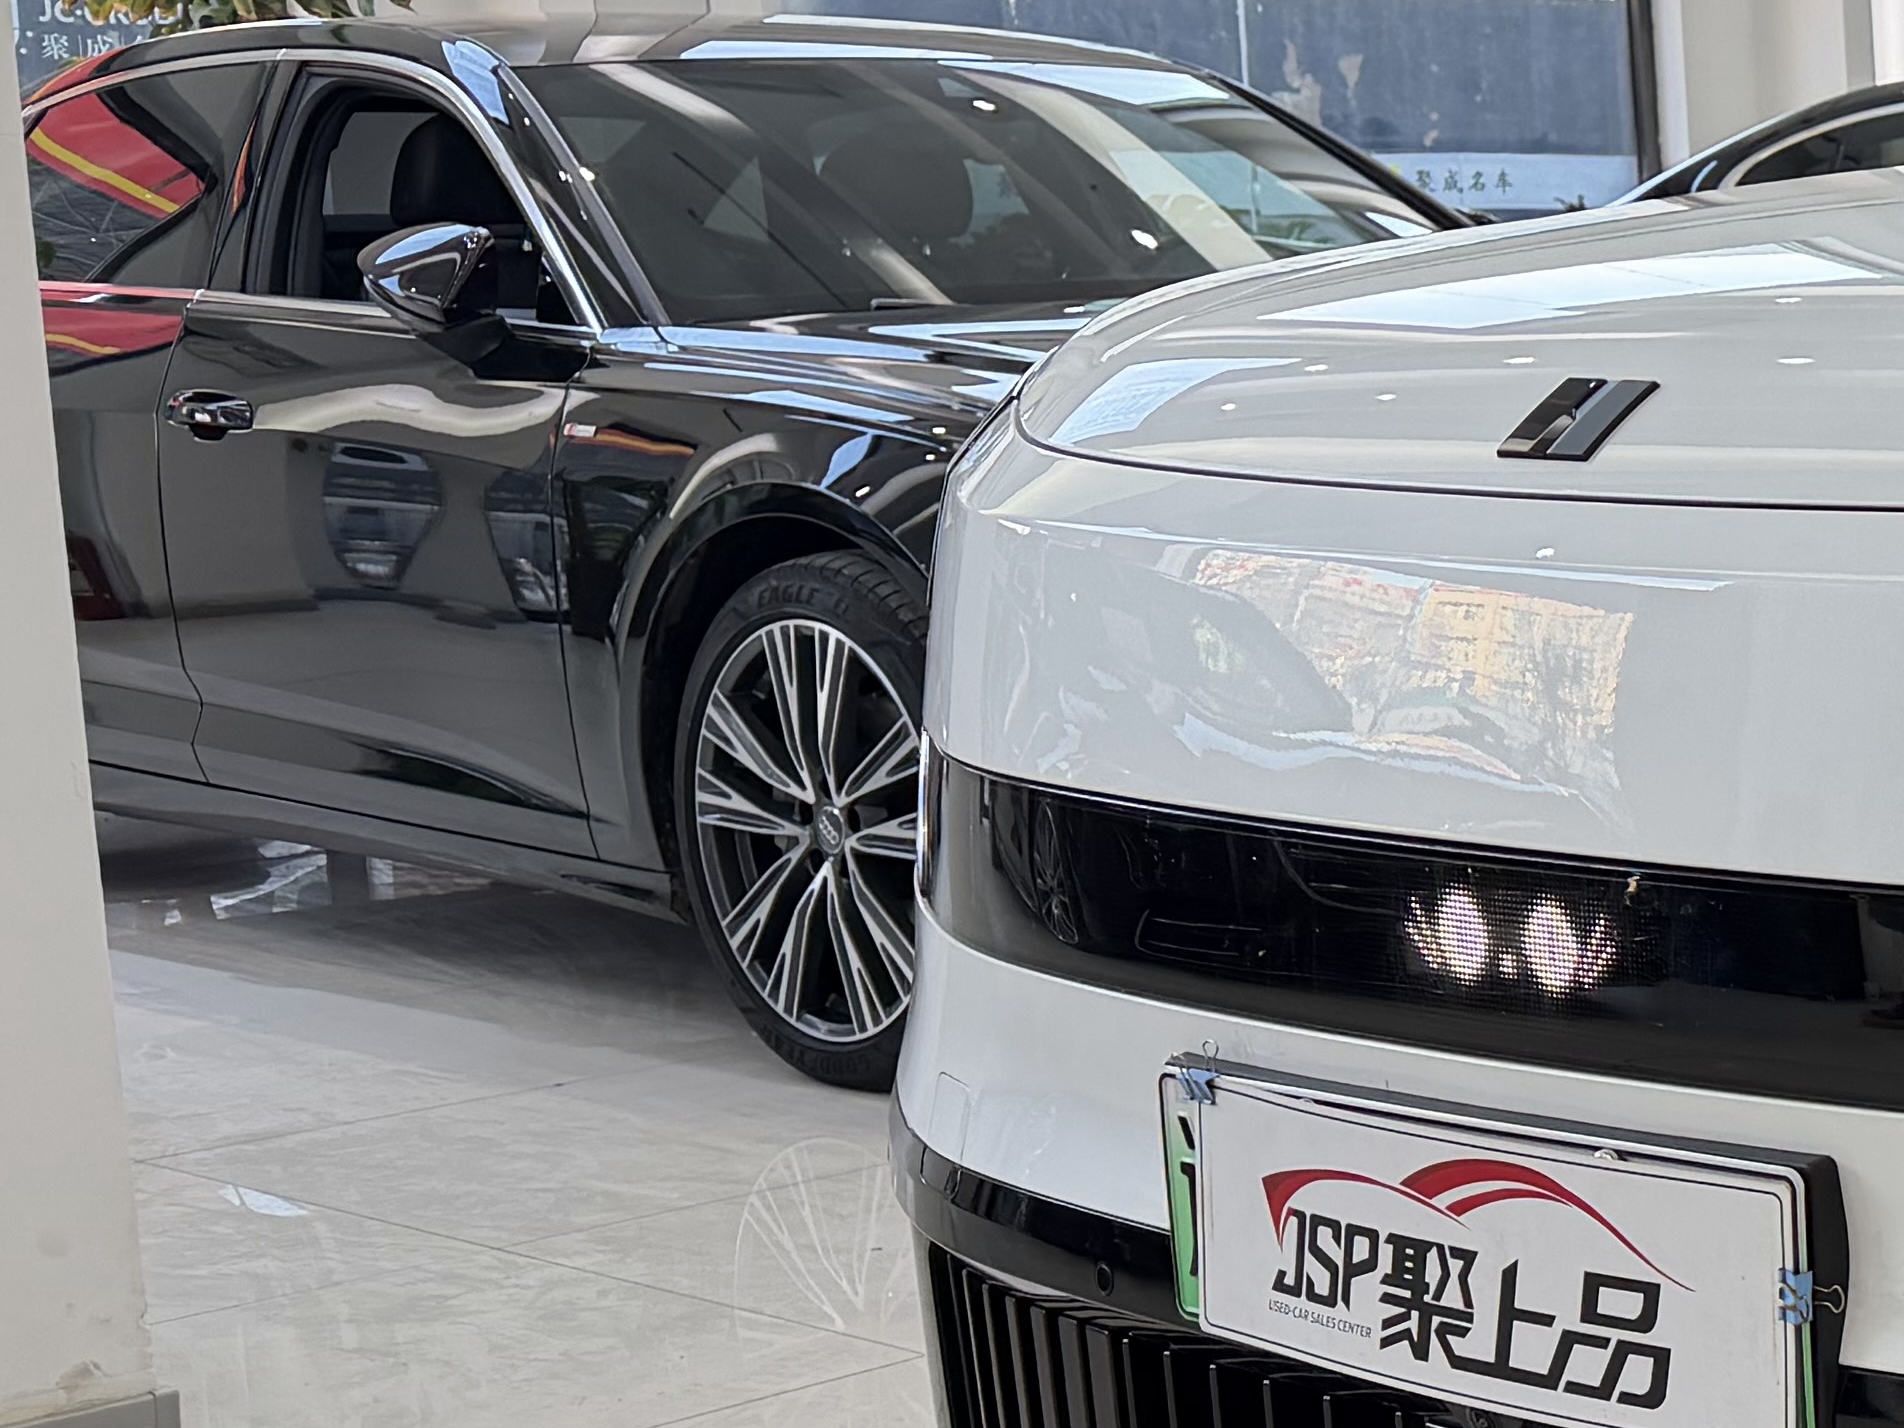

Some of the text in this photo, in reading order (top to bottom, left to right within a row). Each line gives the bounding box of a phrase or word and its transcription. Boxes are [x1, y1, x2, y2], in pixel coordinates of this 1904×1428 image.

[757, 582, 820, 610] EAGLE
[1310, 1311, 1336, 1329] SALES
[1337, 1319, 1372, 1338] CENTER
